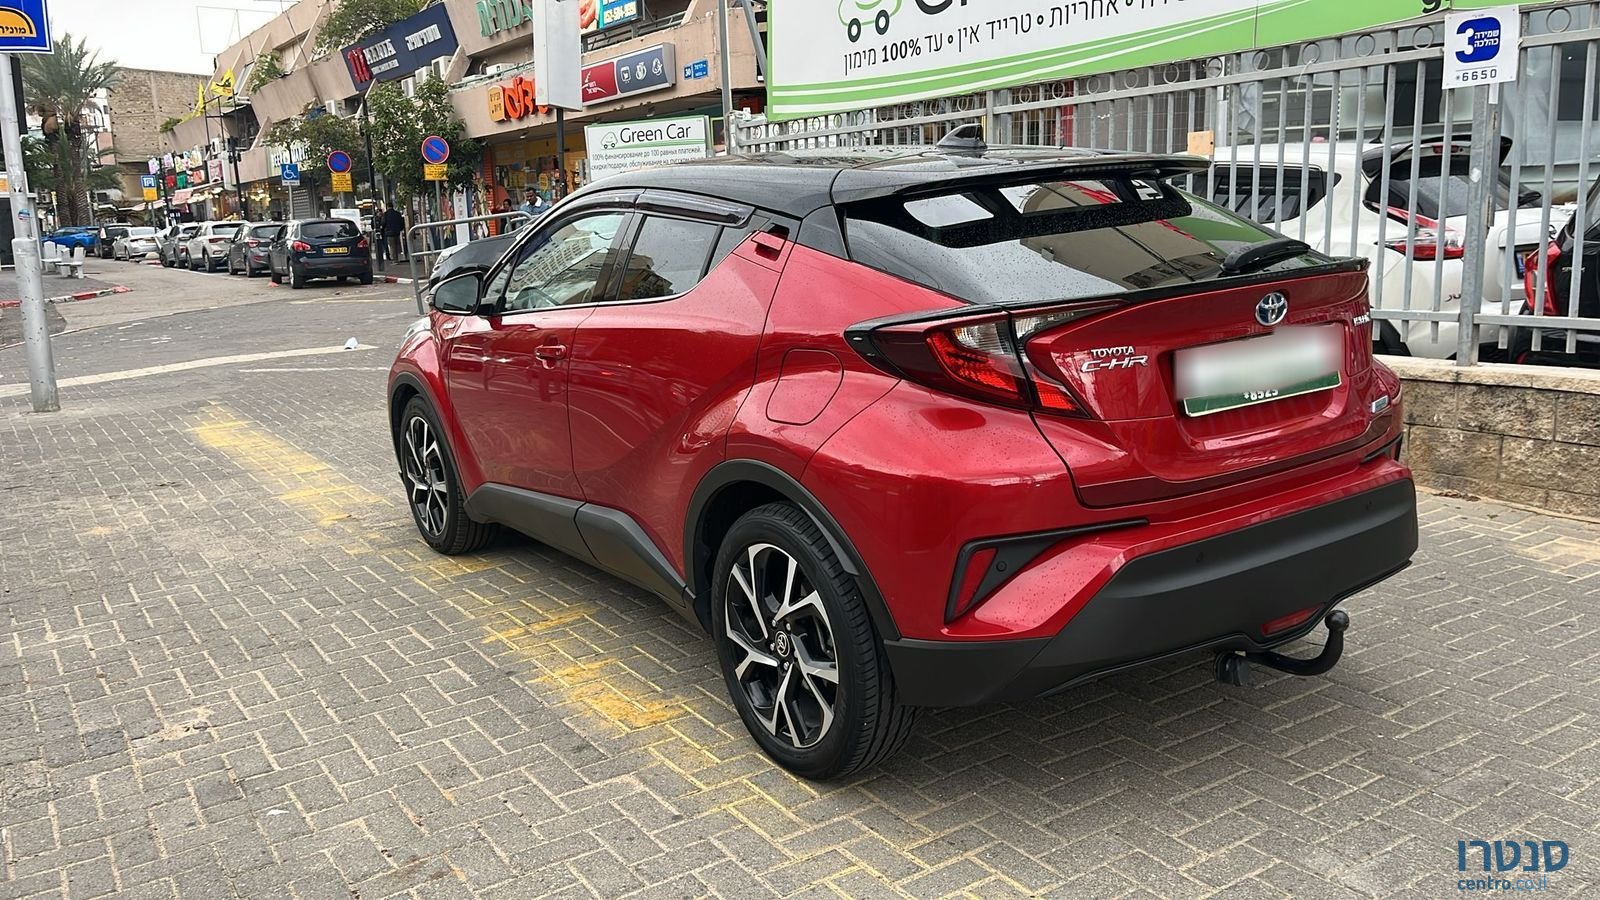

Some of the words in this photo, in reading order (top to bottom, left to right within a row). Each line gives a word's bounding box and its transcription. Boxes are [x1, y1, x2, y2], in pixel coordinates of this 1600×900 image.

[1049, 0, 1119, 28] אחריות
[985, 13, 1032, 40] טרייד
[1474, 29, 1499, 40] שמירה
[924, 33, 943, 53] עד
[957, 24, 980, 52] אין
[1474, 38, 1499, 48] כהלכה
[882, 38, 922, 63] 100%
[844, 48, 877, 76] מימון
[620, 127, 663, 143] Green
[666, 123, 691, 139] Car
[605, 150, 643, 161] финансирование
[1090, 346, 1135, 358] TOYOTA
[1080, 355, 1148, 373] C-HR
